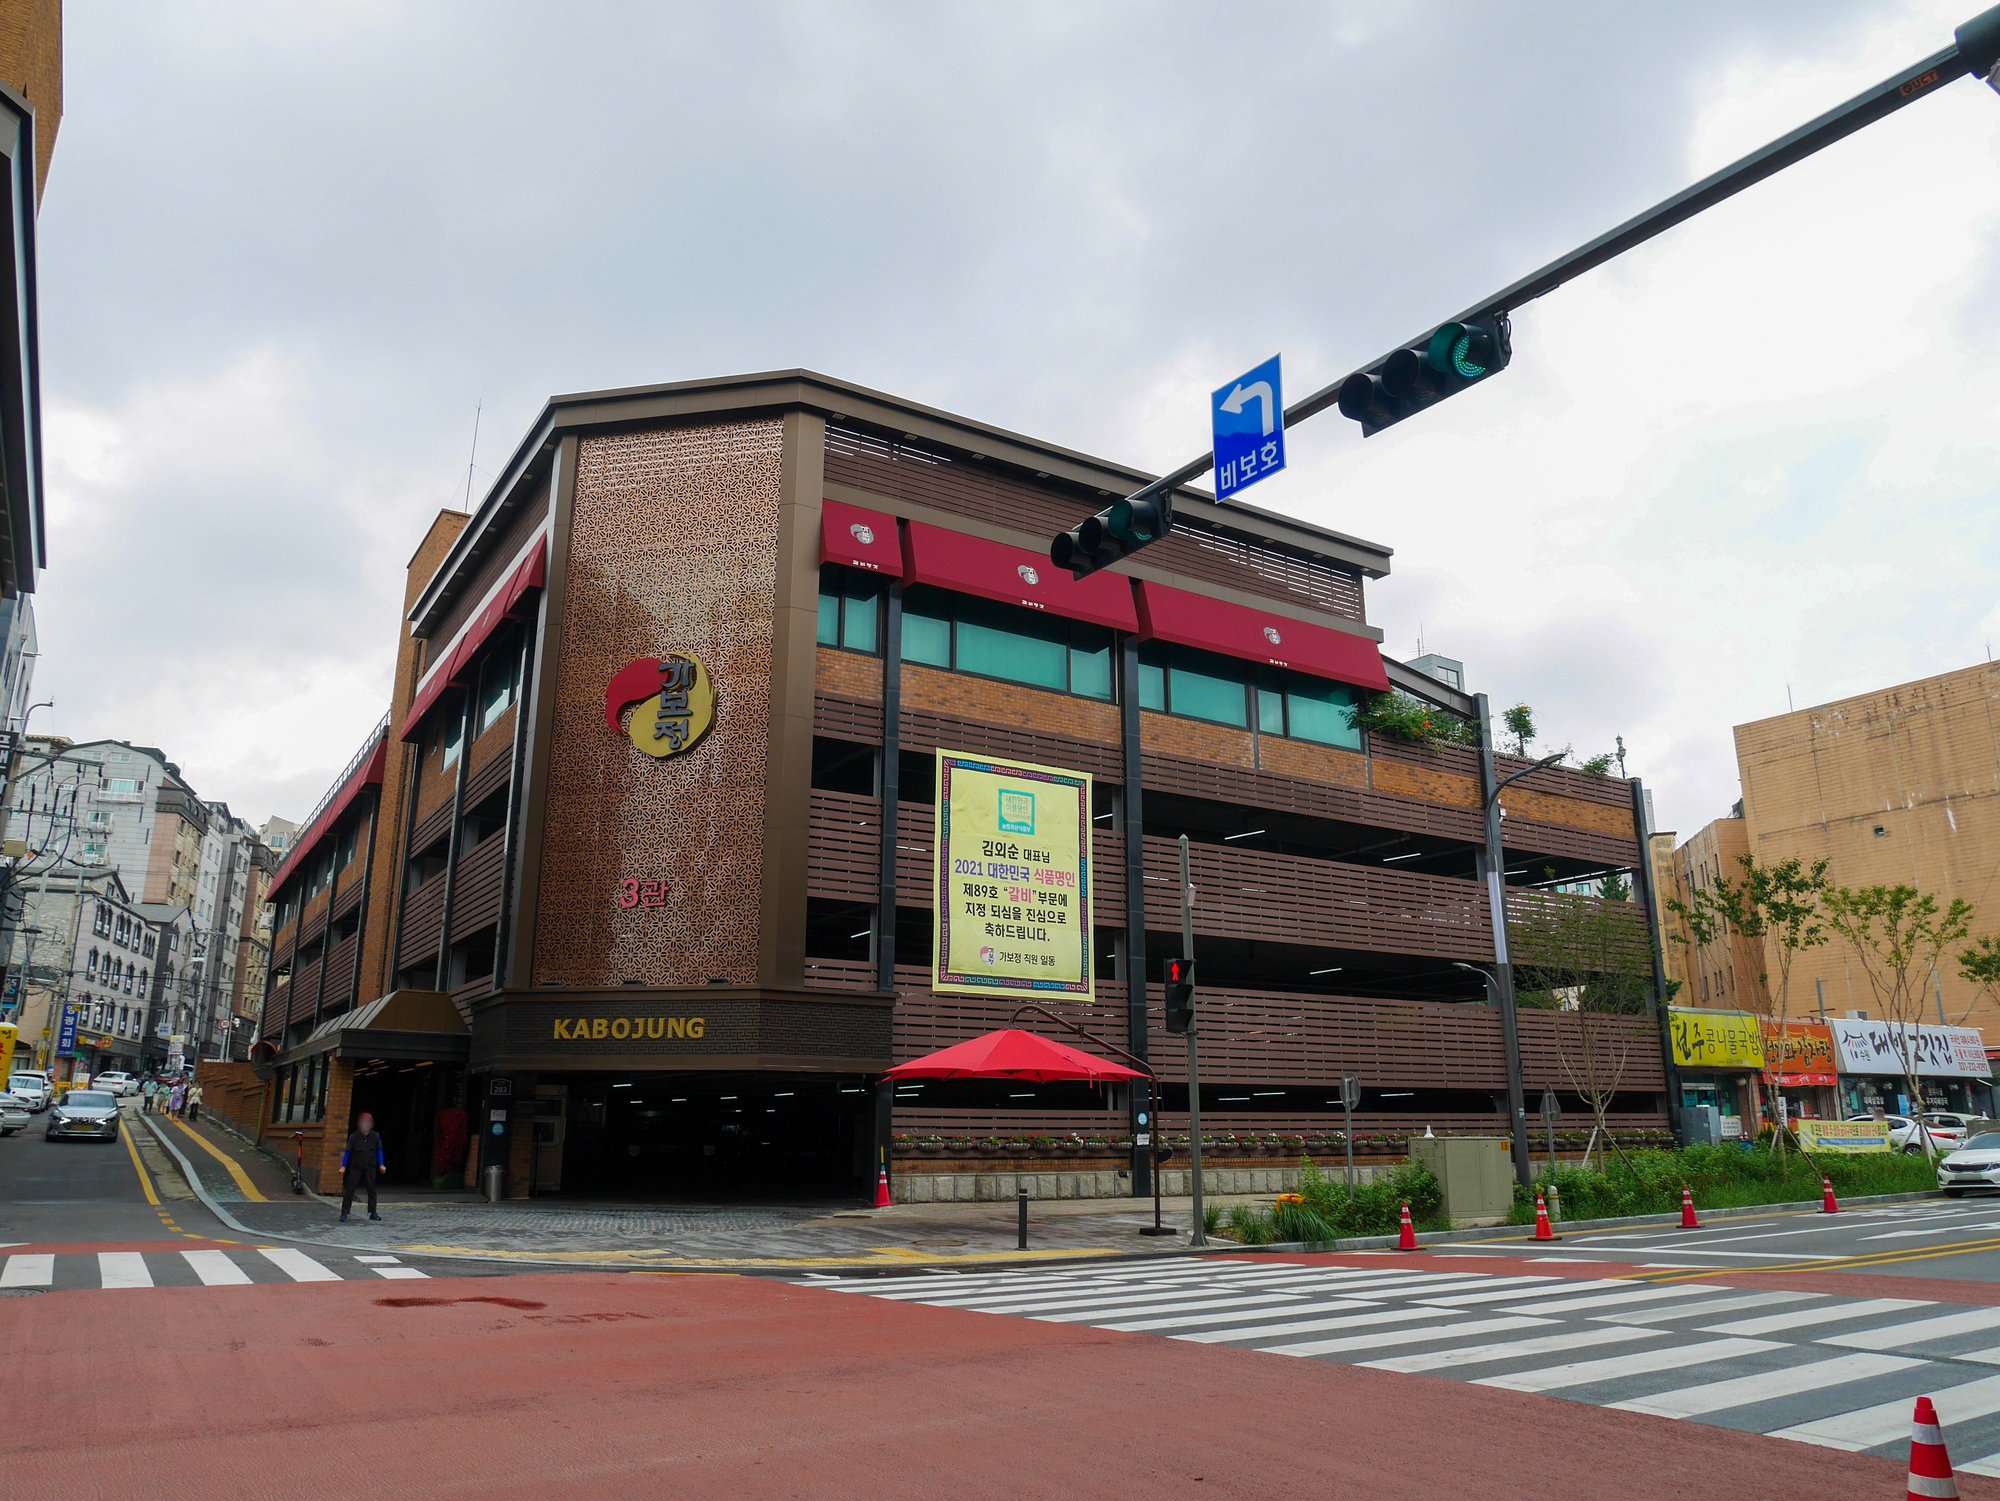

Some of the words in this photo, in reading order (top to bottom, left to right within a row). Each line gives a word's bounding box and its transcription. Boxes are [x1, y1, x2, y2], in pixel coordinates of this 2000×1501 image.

[1220, 440, 1279, 490] 비보호
[653, 659, 696, 750] 가보정
[982, 839, 1019, 858] 김외순
[1023, 848, 1050, 864] 대표님
[954, 858, 984, 877] 2021
[987, 862, 1030, 883] 대한민국
[1033, 868, 1076, 888] 식품명인
[618, 877, 669, 908] 3관
[962, 882, 998, 900] 제89호
[965, 902, 986, 917] 지정
[990, 904, 1022, 922] 되심을
[1026, 909, 1067, 925] 진심으로
[984, 923, 1050, 942] 축하드립니다.
[1000, 950, 1022, 964] 가보정
[1023, 952, 1038, 966] 직원
[1041, 953, 1056, 967] 일동
[553, 1017, 705, 1040] KABOJUNG
